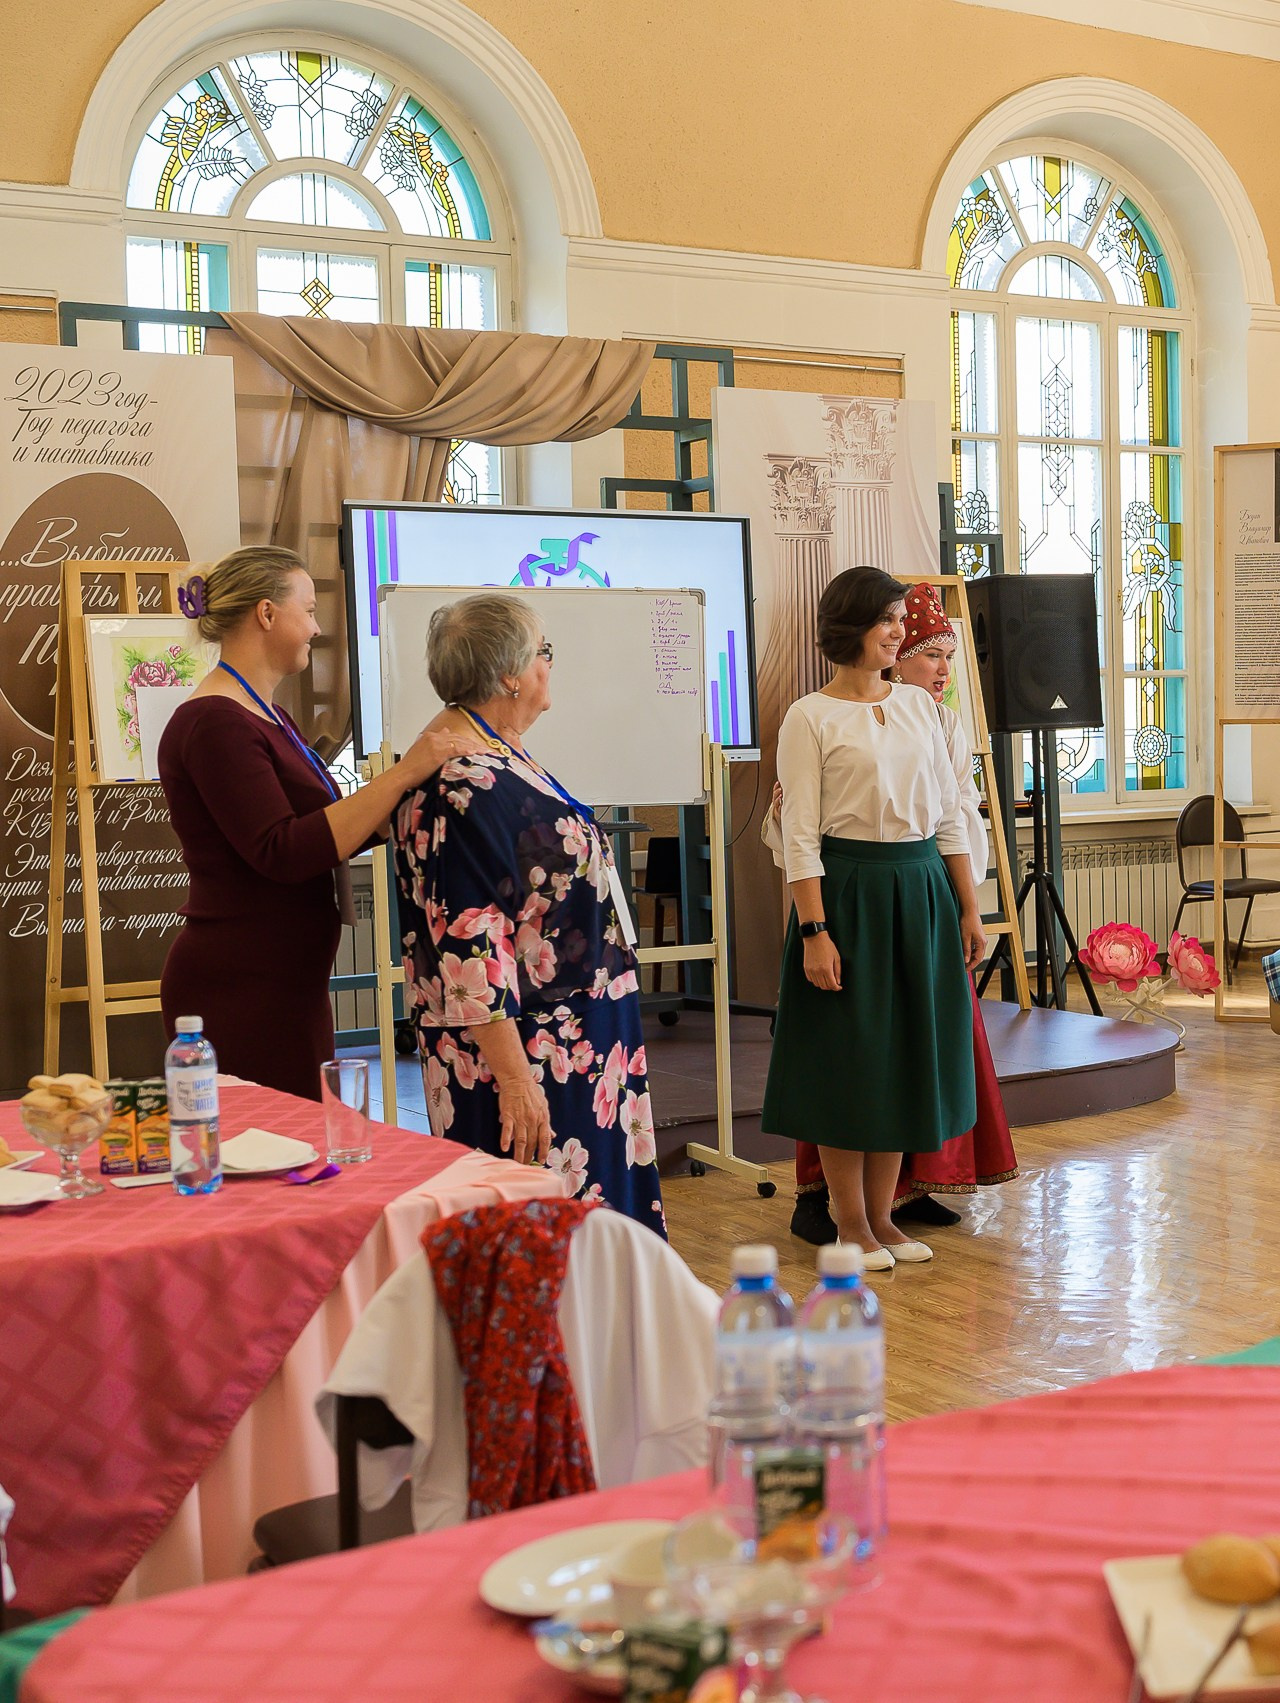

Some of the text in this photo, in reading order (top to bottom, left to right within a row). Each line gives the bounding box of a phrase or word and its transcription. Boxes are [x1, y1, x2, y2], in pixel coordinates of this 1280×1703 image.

[12, 406, 155, 446] Год педагога
[12, 438, 156, 467] и наставника
